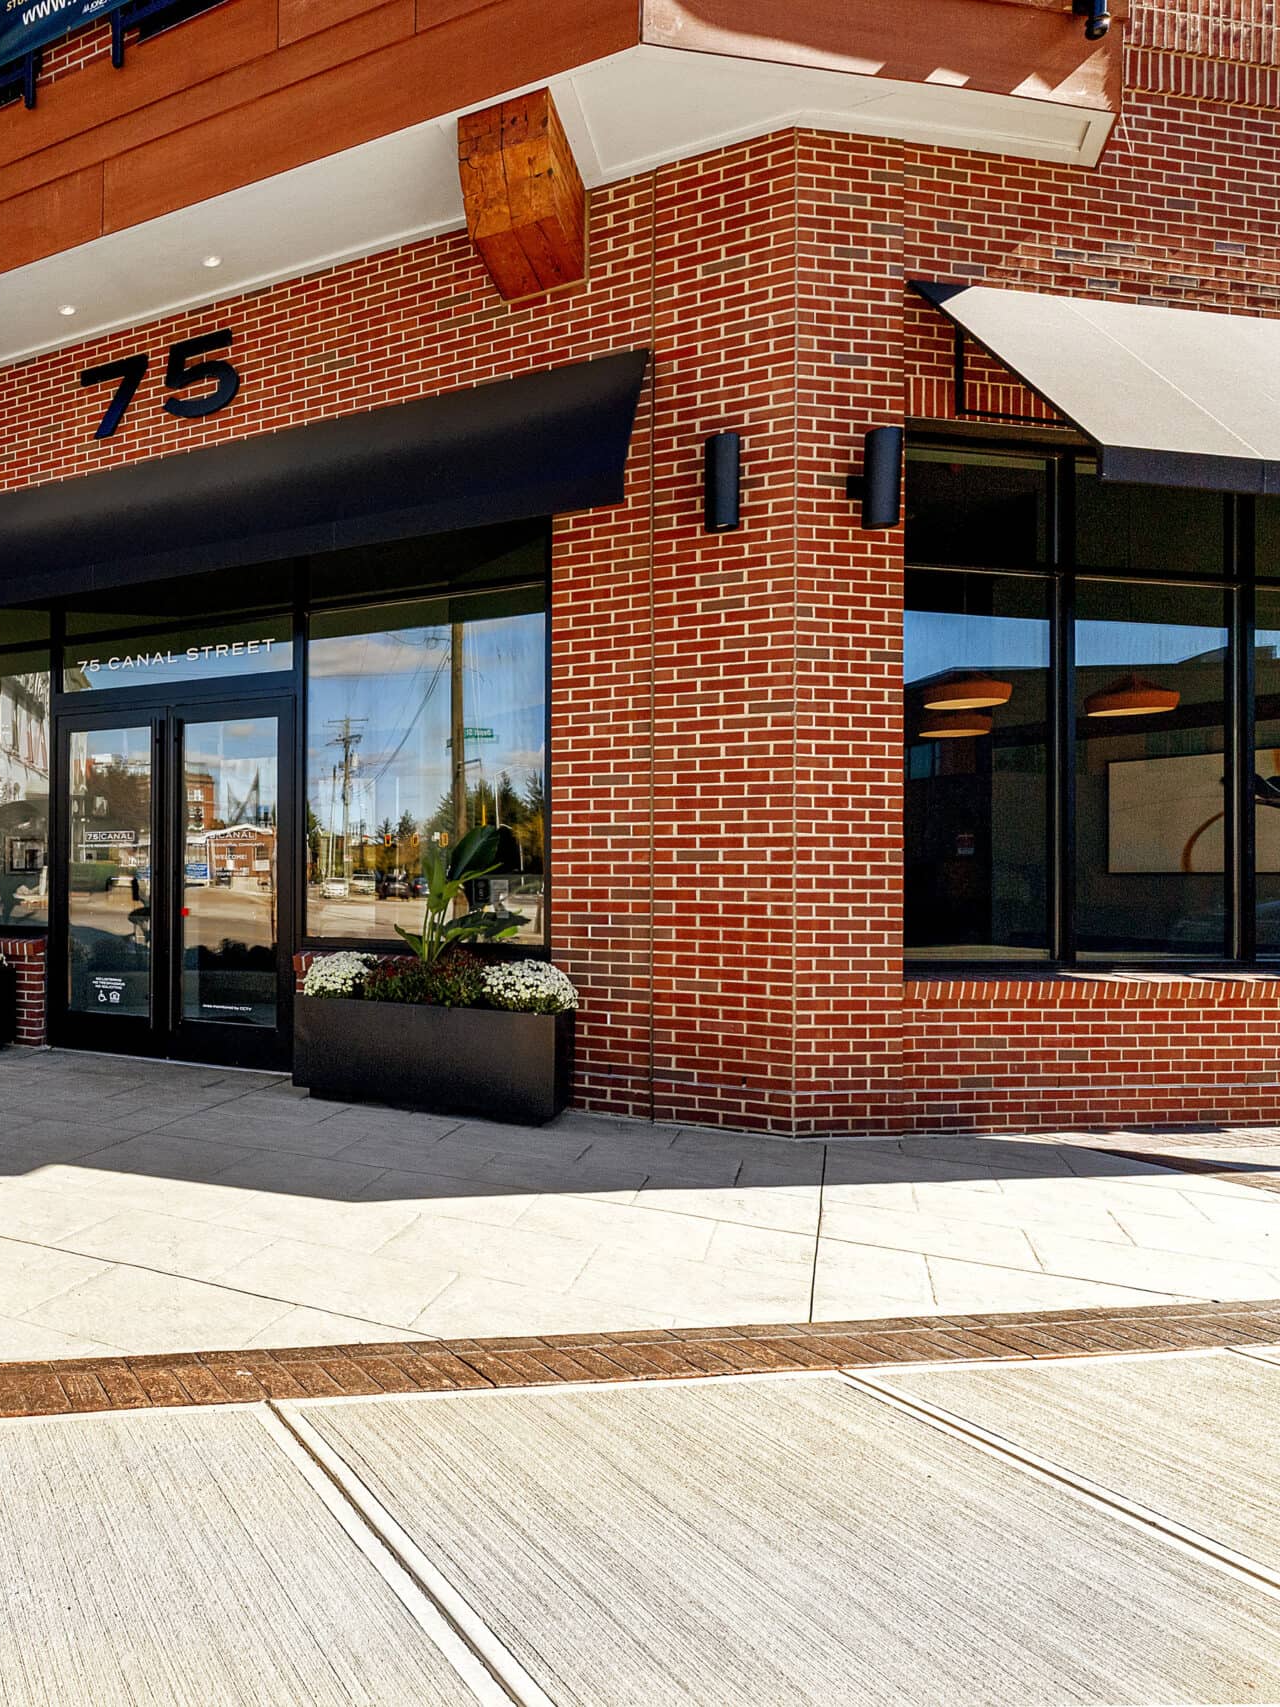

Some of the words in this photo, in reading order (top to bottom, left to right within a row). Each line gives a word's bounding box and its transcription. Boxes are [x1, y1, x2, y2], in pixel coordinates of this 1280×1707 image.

[80, 328, 240, 440] 75
[77, 661, 100, 673] 75
[108, 650, 178, 670] CANAL
[186, 638, 276, 661] STREET
[87, 832, 99, 840] 75
[100, 831, 134, 840] CANAL
[218, 830, 255, 840] CANAL
